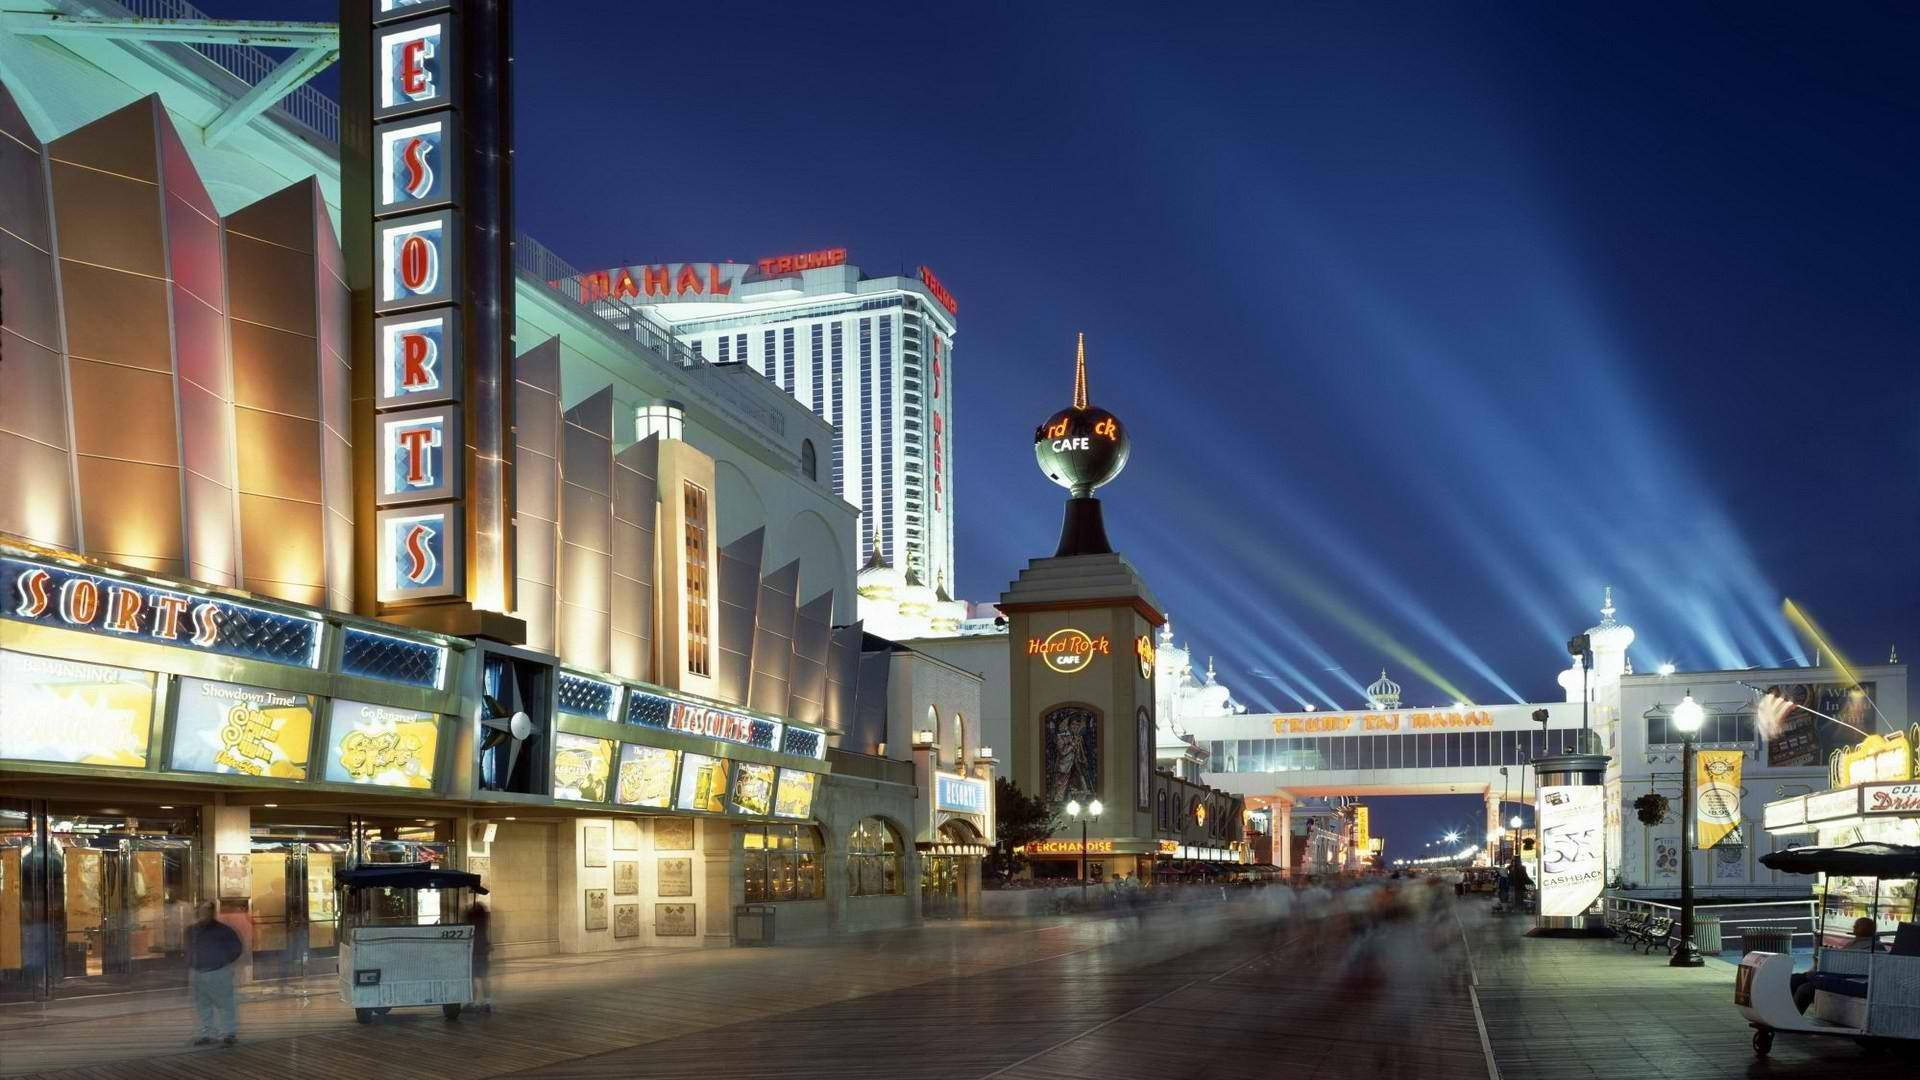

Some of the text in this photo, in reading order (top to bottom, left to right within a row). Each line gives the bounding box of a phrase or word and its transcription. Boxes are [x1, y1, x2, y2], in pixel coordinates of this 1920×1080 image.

[758, 248, 847, 274] TRUMP
[400, 0, 441, 585] ESORTS
[1051, 437, 1090, 453] CAFE
[1028, 635, 1110, 655] Hard Rock
[1056, 655, 1081, 665] CAFE
[201, 682, 297, 707] Showdown Time!
[360, 706, 376, 719] Go
[1271, 711, 1494, 735] TRUMP TAJ MAHAL
[1891, 785, 1920, 795] COL
[441, 930, 464, 940] 827
